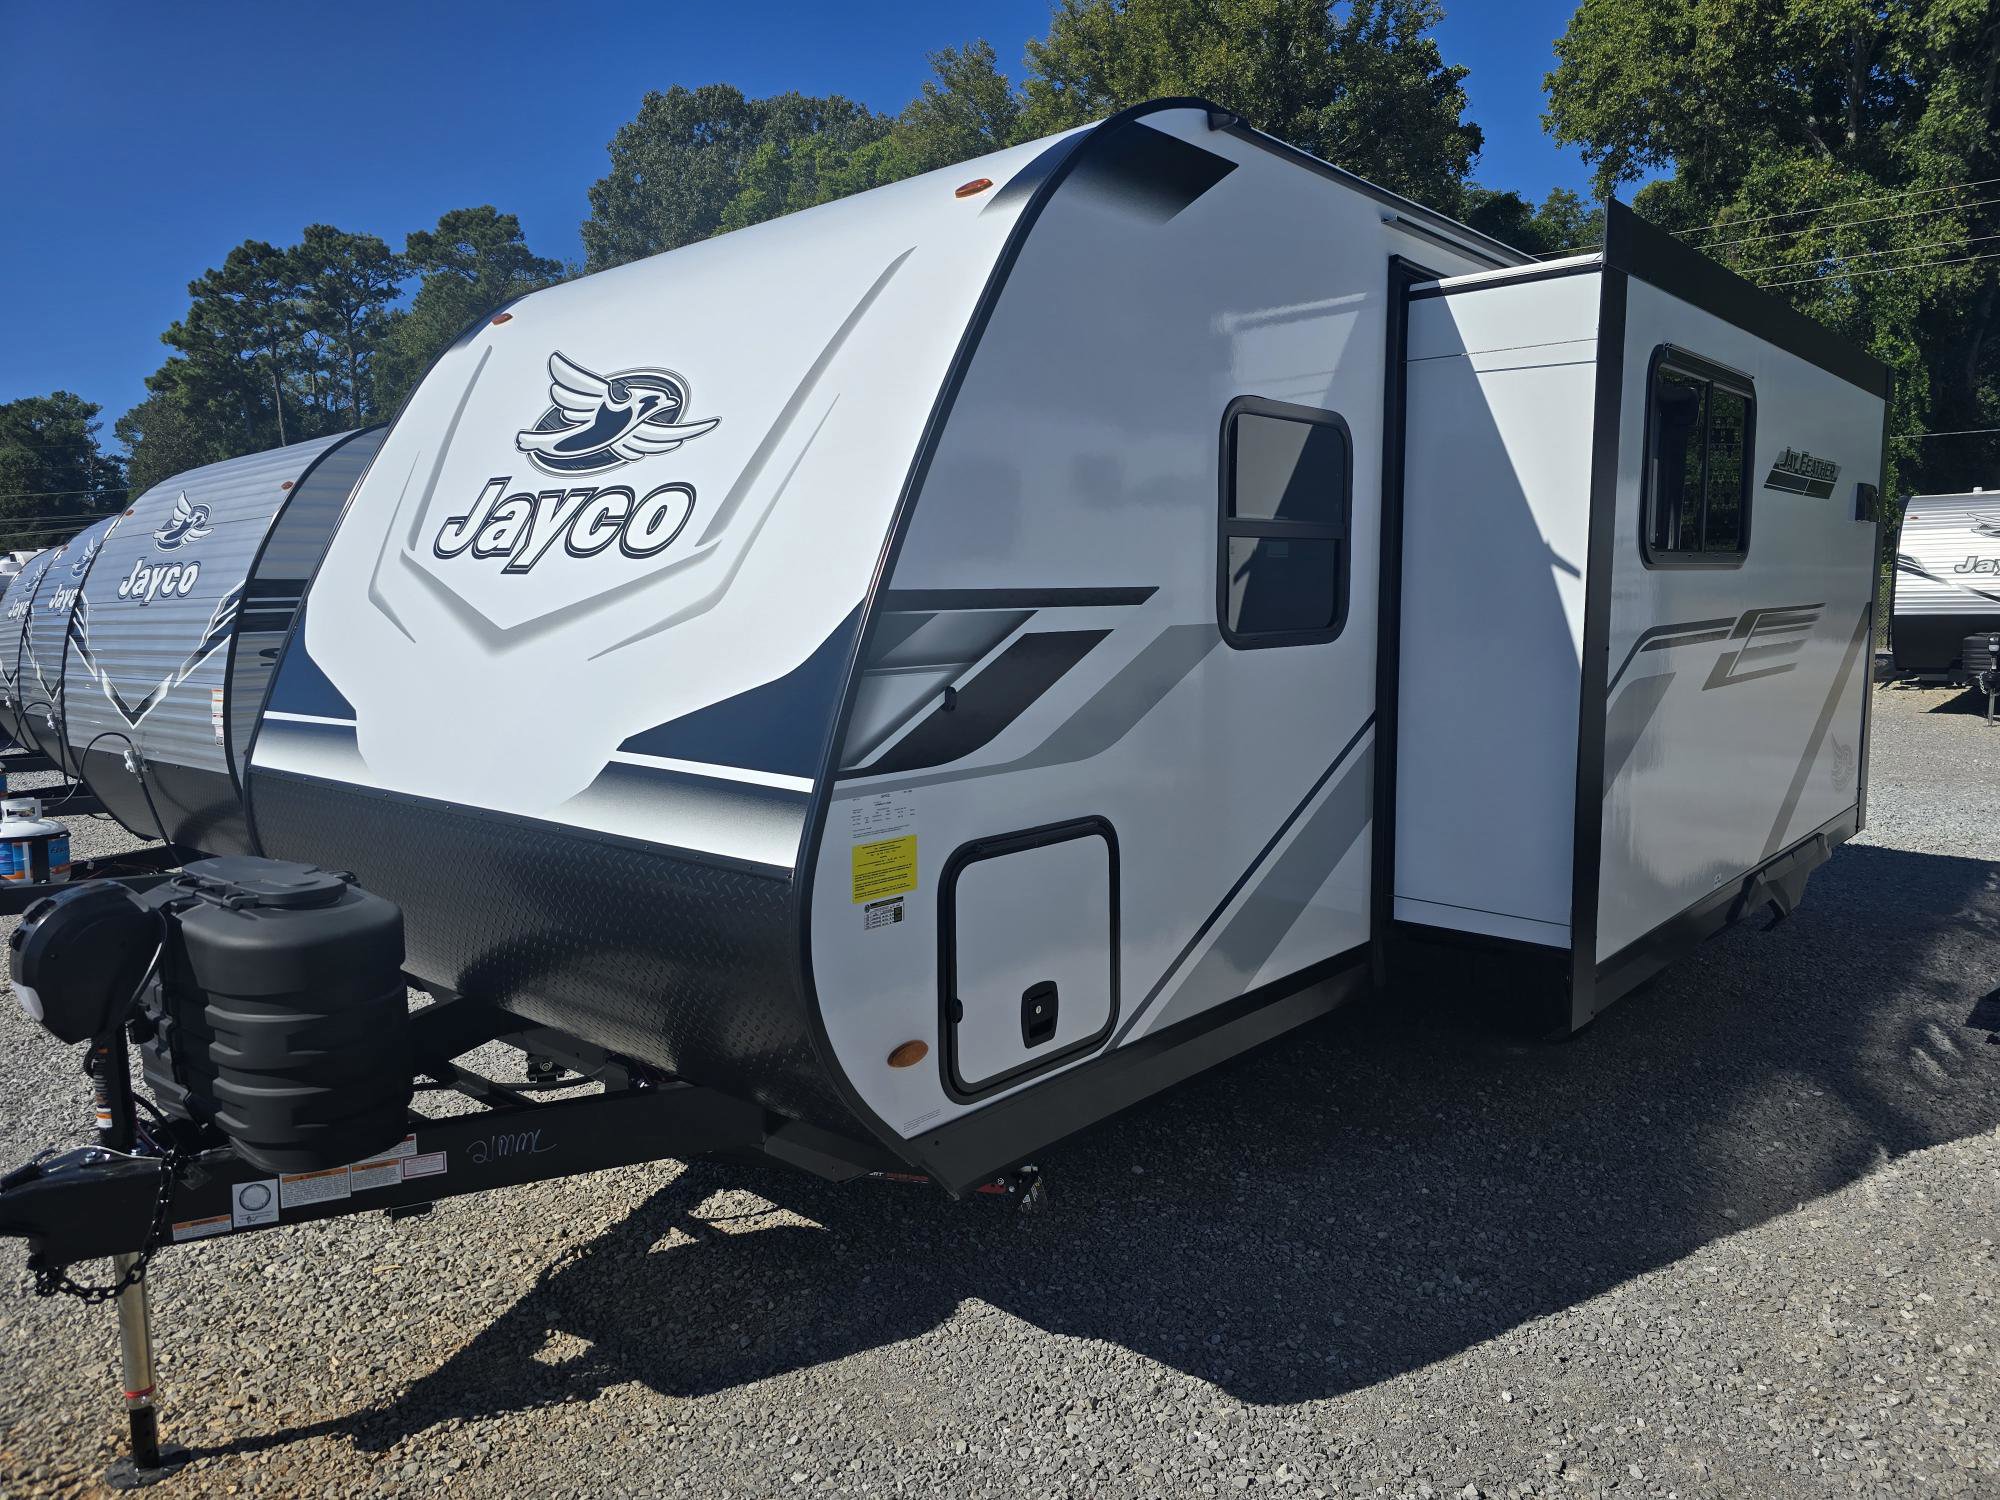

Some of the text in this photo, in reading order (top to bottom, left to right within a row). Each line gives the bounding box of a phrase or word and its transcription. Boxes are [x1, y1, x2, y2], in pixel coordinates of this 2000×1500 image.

[433, 476, 697, 574] Jayco
[48, 584, 80, 616] Jayc
[117, 556, 201, 606] Jayco
[7, 598, 31, 622] Jayc
